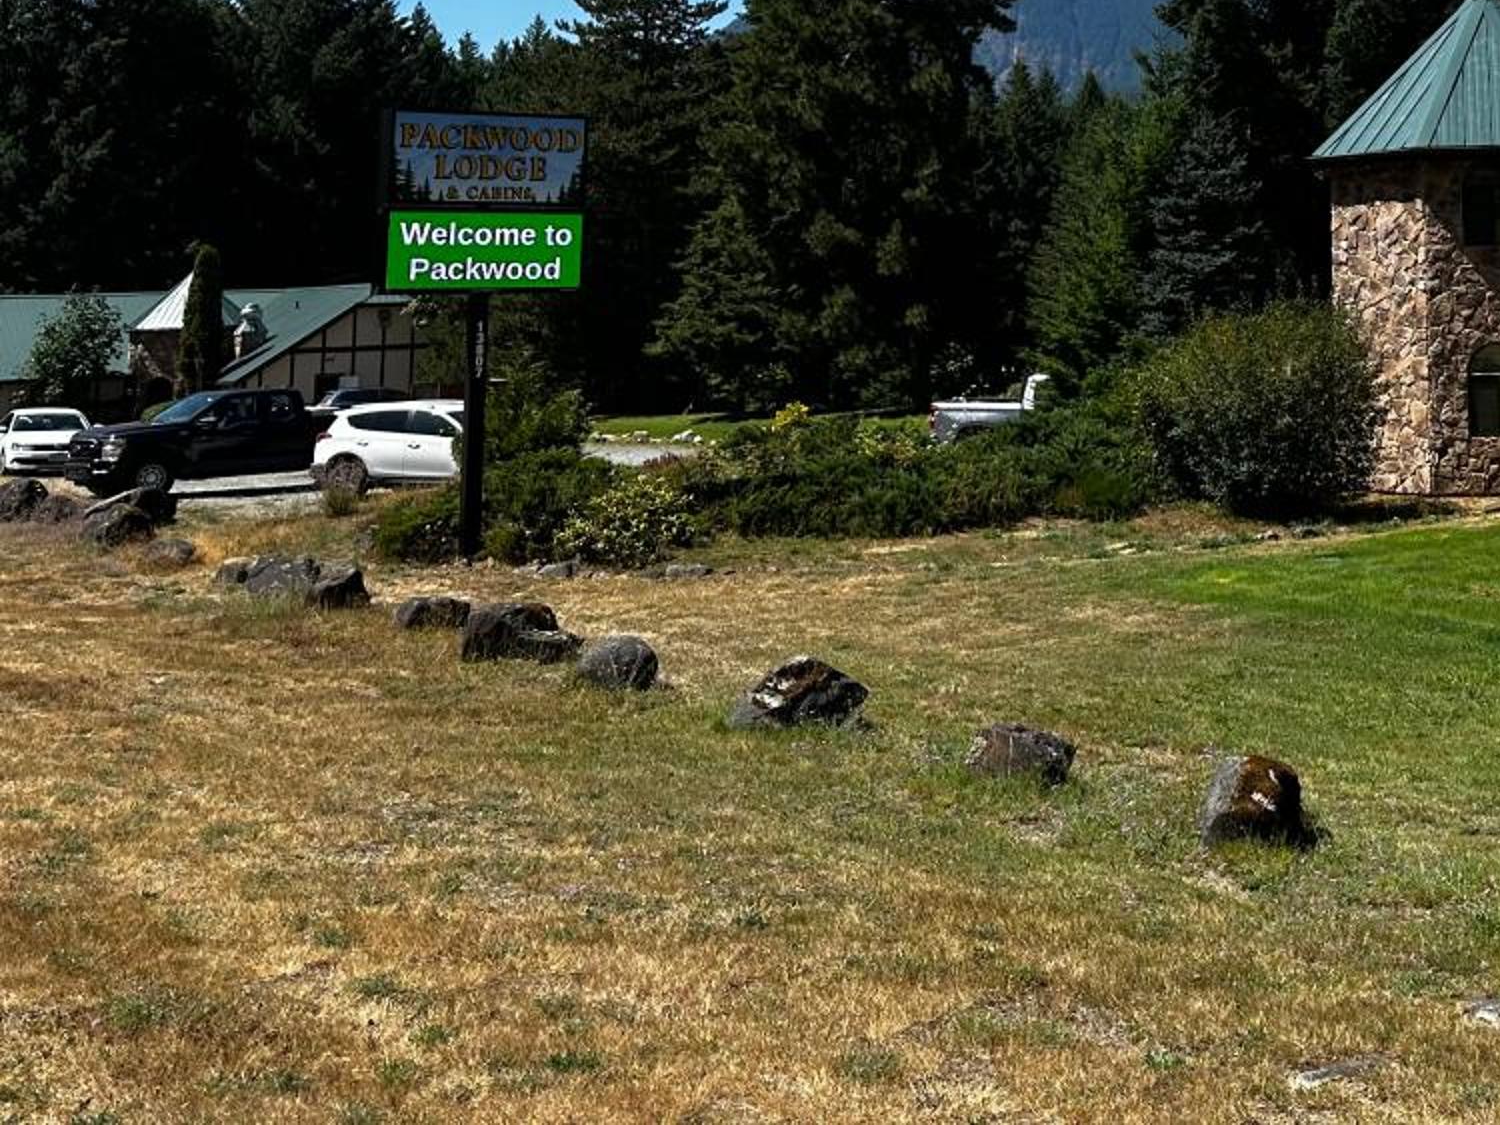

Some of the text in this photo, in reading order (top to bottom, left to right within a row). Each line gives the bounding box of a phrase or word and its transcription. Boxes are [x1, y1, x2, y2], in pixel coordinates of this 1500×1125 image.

[400, 123, 580, 152] PACKWOOD
[434, 154, 547, 181] LODGE
[465, 186, 533, 200] CABINS
[400, 222, 573, 246] Welcome to
[409, 257, 561, 281] Packwood
